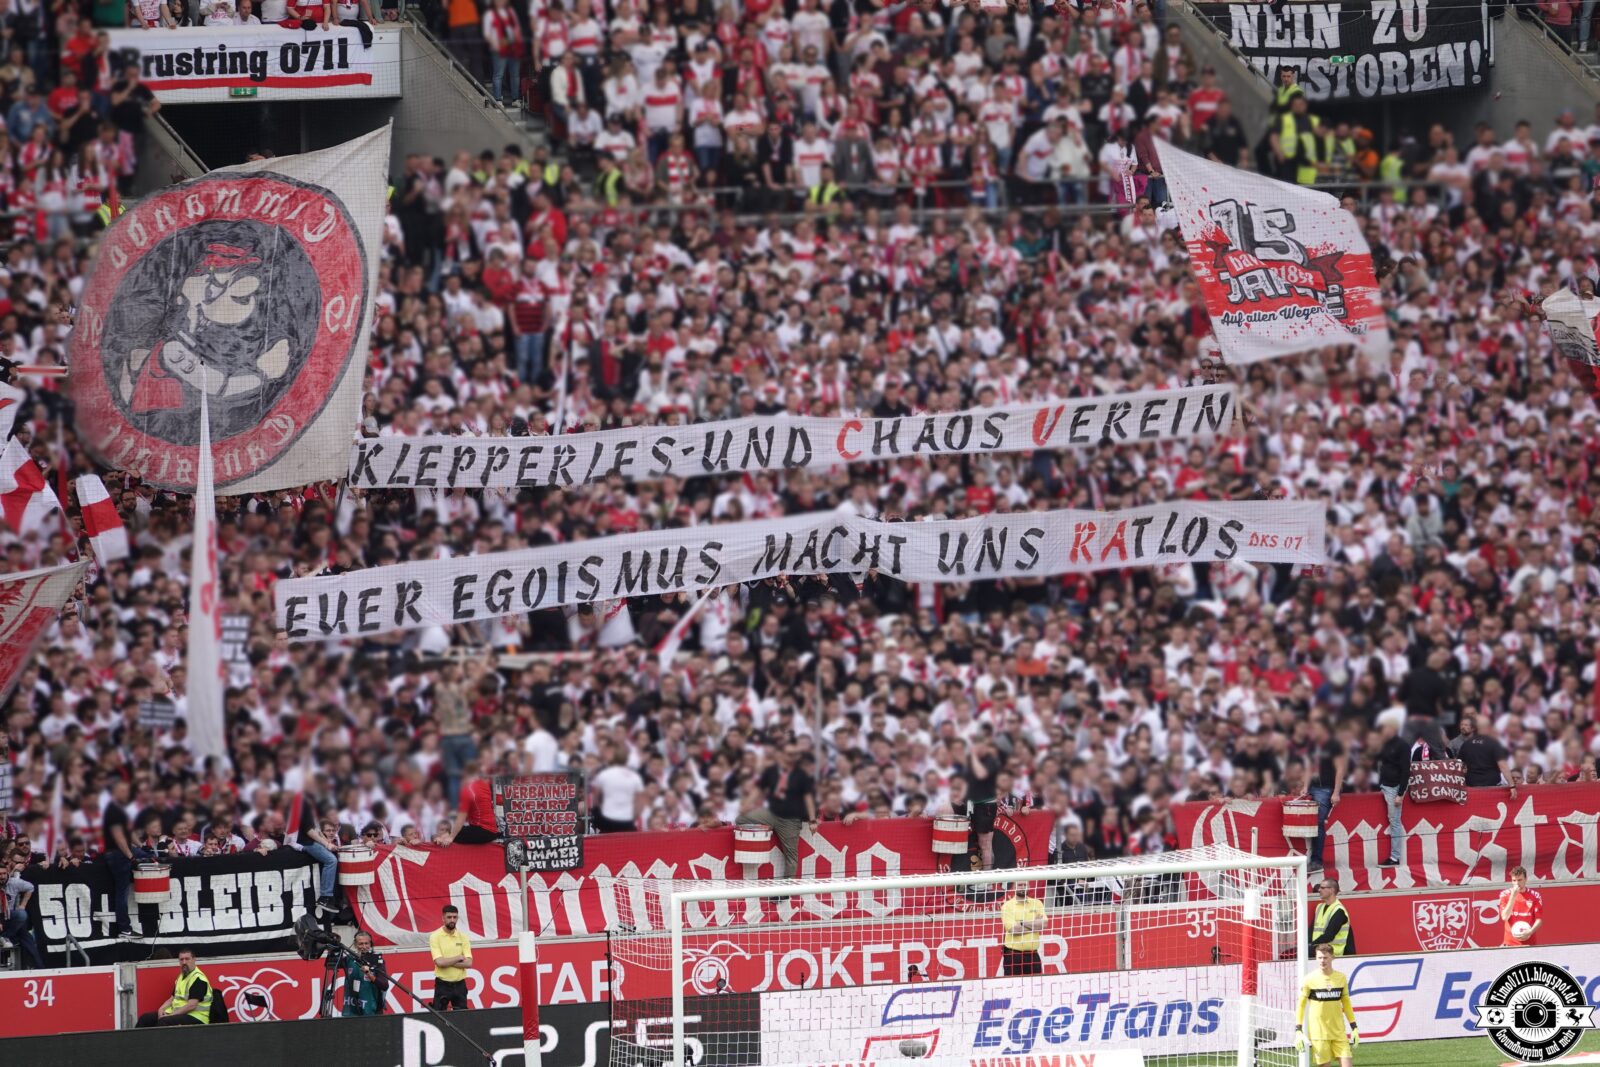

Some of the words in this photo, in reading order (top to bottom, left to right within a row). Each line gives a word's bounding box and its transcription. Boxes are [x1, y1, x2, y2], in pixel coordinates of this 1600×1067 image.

[1228, 3, 1341, 49] NEIN
[1371, 0, 1428, 44] ZU
[279, 38, 349, 74] 0711
[1221, 311, 1243, 327] Auf
[1246, 311, 1277, 322] allen
[836, 411, 1010, 460] CHAOS
[1031, 392, 1232, 447] VEREIN
[285, 579, 422, 639] EUER
[453, 540, 723, 620] EGOISMUS
[752, 524, 907, 576] MACHT
[937, 526, 1045, 577] UNS
[1068, 512, 1244, 564] RATLOS
[1249, 530, 1278, 548] DKS
[1283, 535, 1304, 552] 07
[503, 784, 576, 800] VERBANNTE
[510, 799, 570, 811] KEHRT
[526, 846, 580, 861] IMMER
[527, 838, 546, 850] DU
[550, 835, 578, 849] BIST
[1187, 910, 1216, 938] 35
[23, 979, 56, 1009] 34
[973, 992, 1224, 1055] EgeTrans
